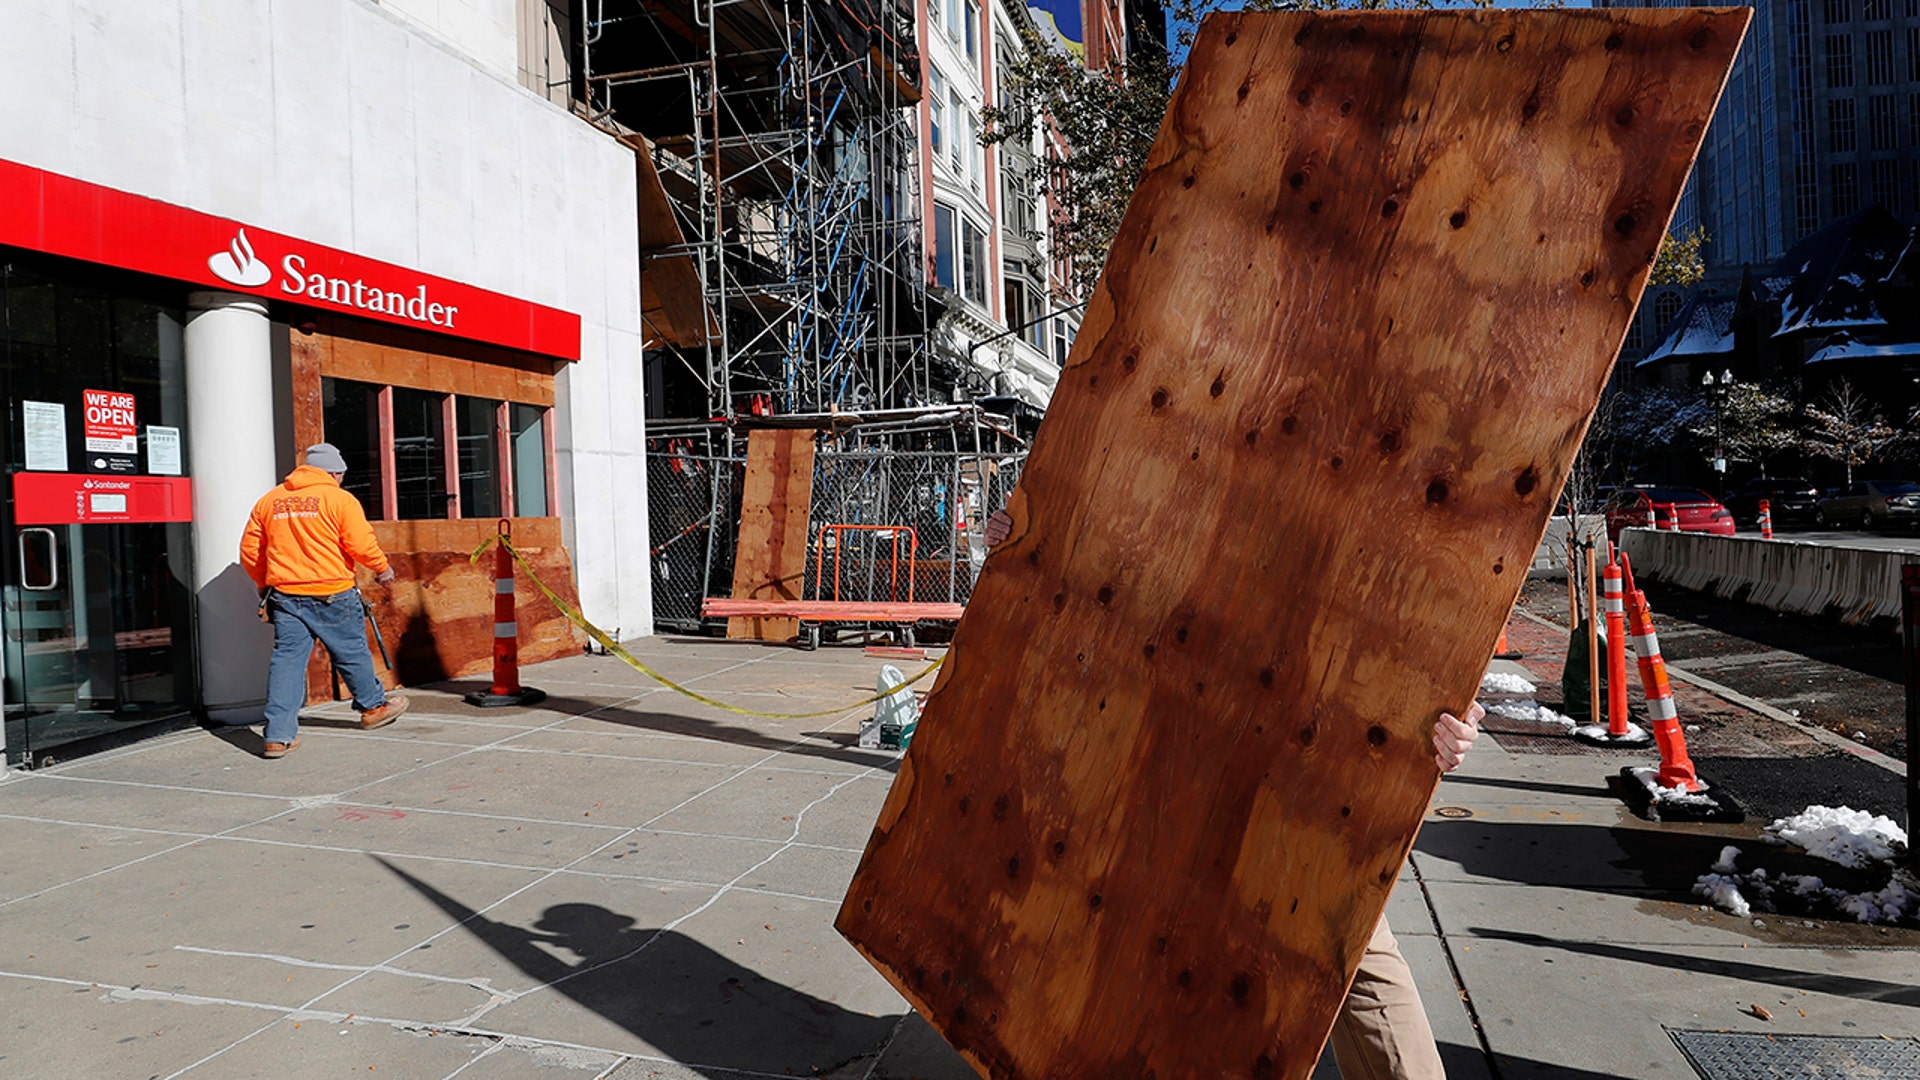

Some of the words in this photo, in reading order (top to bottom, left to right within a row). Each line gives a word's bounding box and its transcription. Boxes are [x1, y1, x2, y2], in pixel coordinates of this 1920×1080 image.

[281, 254, 458, 328] Santander
[86, 393, 108, 407] WE
[110, 395, 134, 409] ARE
[87, 406, 135, 426] OPEN
[93, 480, 131, 489] Santander
